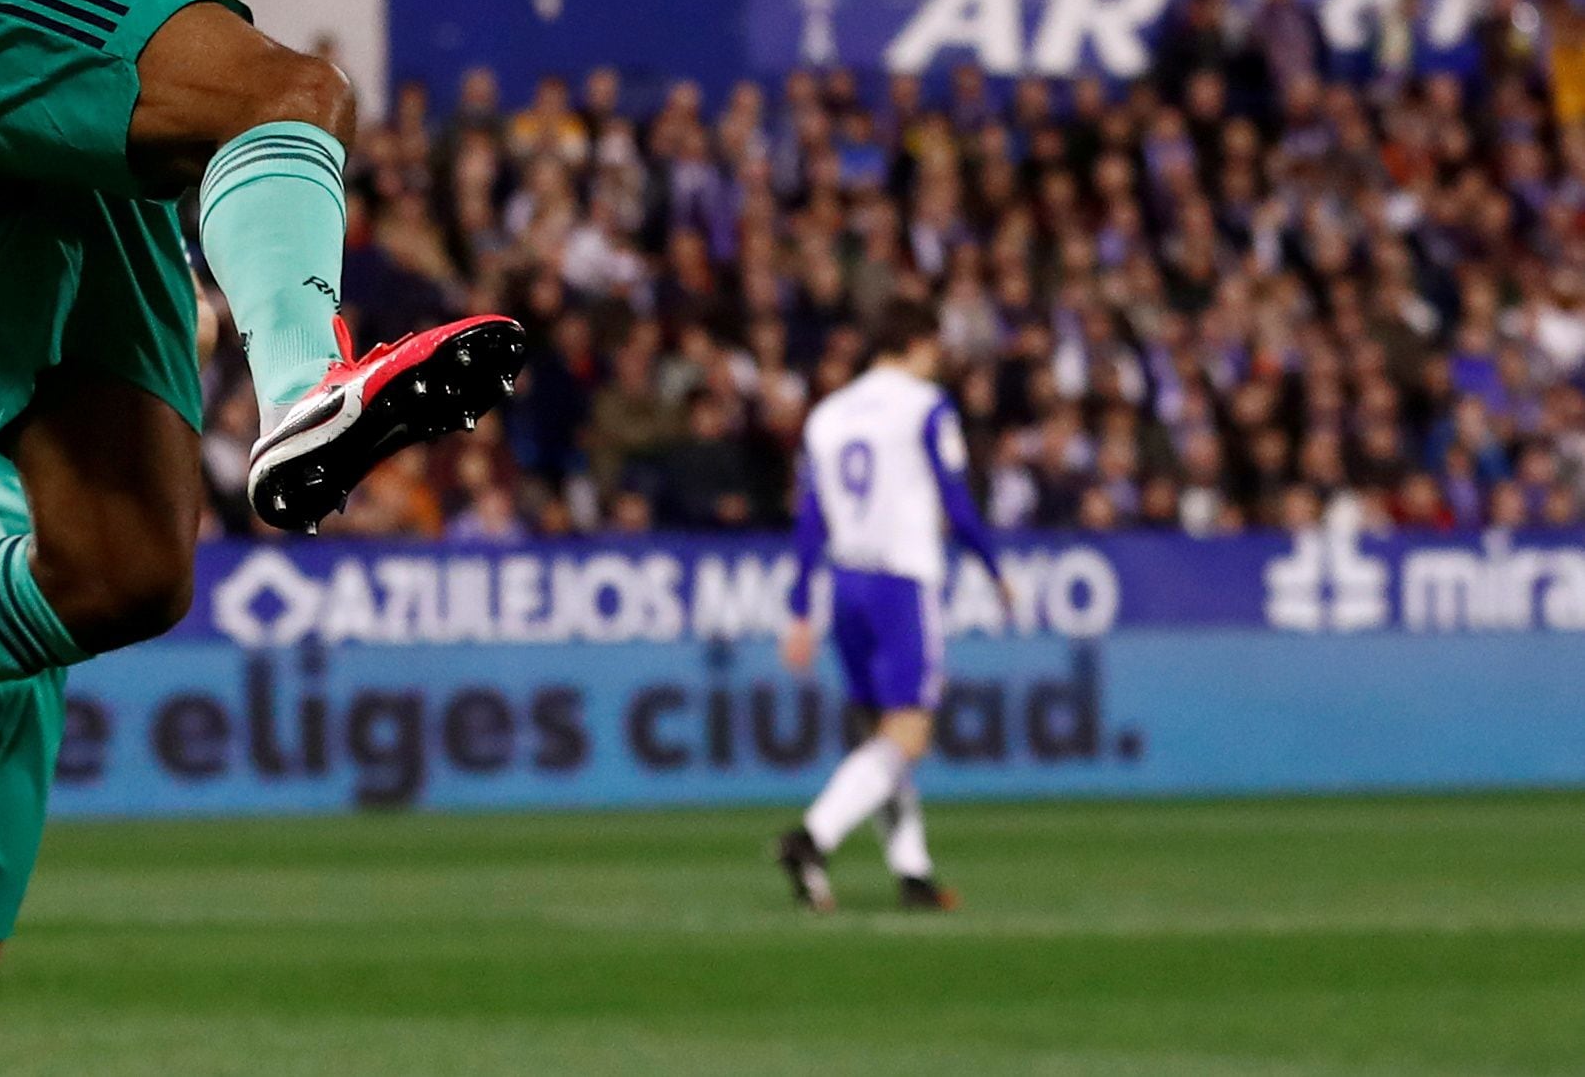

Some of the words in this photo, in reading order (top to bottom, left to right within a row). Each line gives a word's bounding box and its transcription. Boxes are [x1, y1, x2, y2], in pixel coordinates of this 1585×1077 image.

[838, 438, 874, 522] 9
[319, 556, 682, 642] AZULEJOS
[694, 547, 1120, 638] MOAYO
[152, 637, 590, 810] eliges
